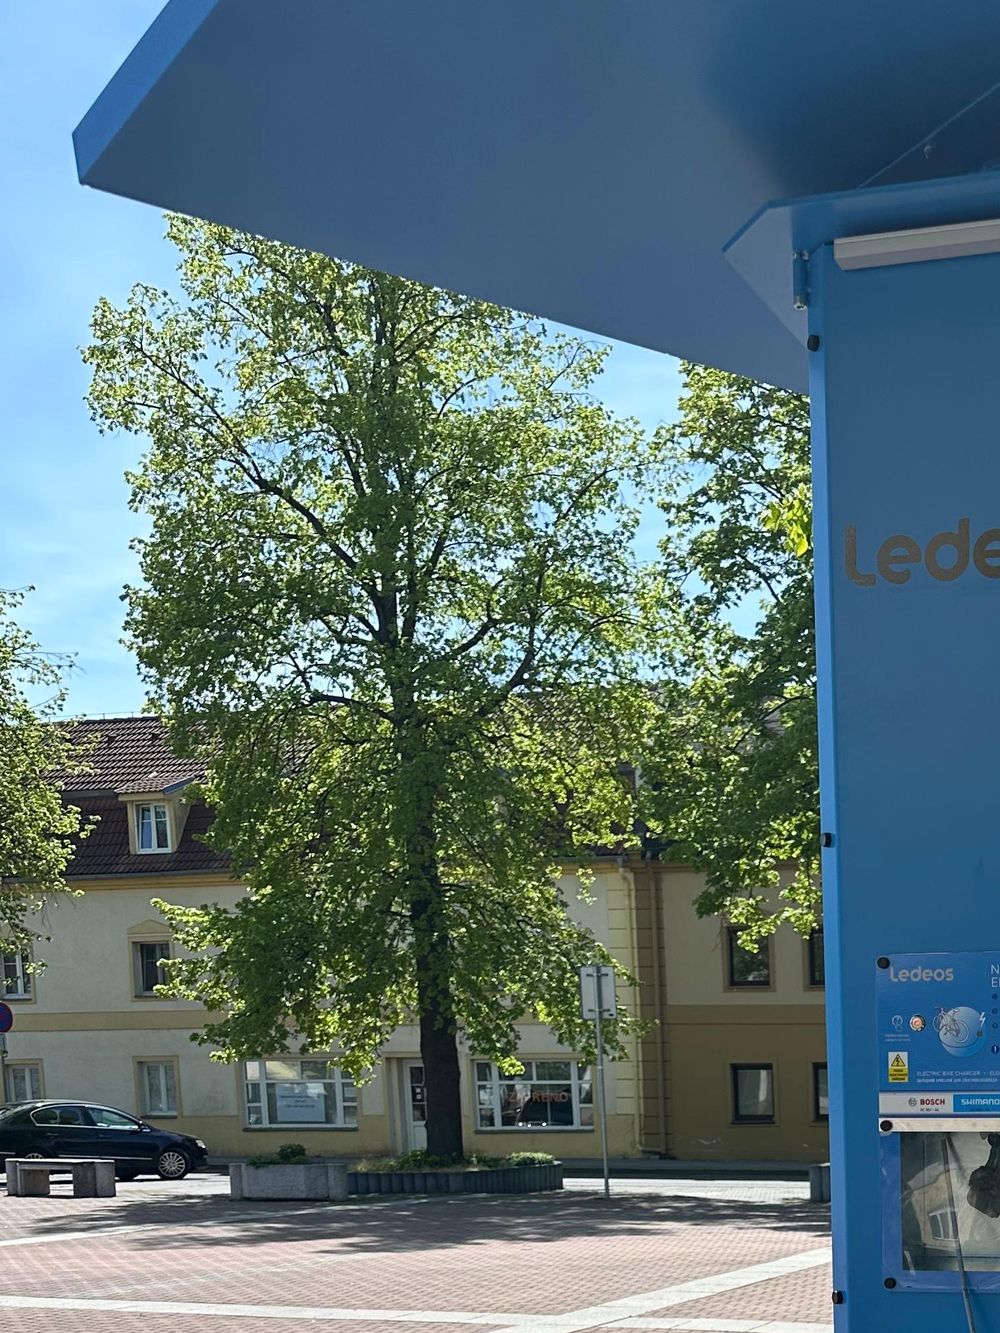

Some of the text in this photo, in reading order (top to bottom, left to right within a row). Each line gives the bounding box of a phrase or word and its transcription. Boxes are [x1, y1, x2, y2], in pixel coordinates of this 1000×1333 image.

[889, 966, 954, 982] Ledeos
[920, 1098, 945, 1106] BOSCH
[961, 1098, 1000, 1106] SHIMANO
